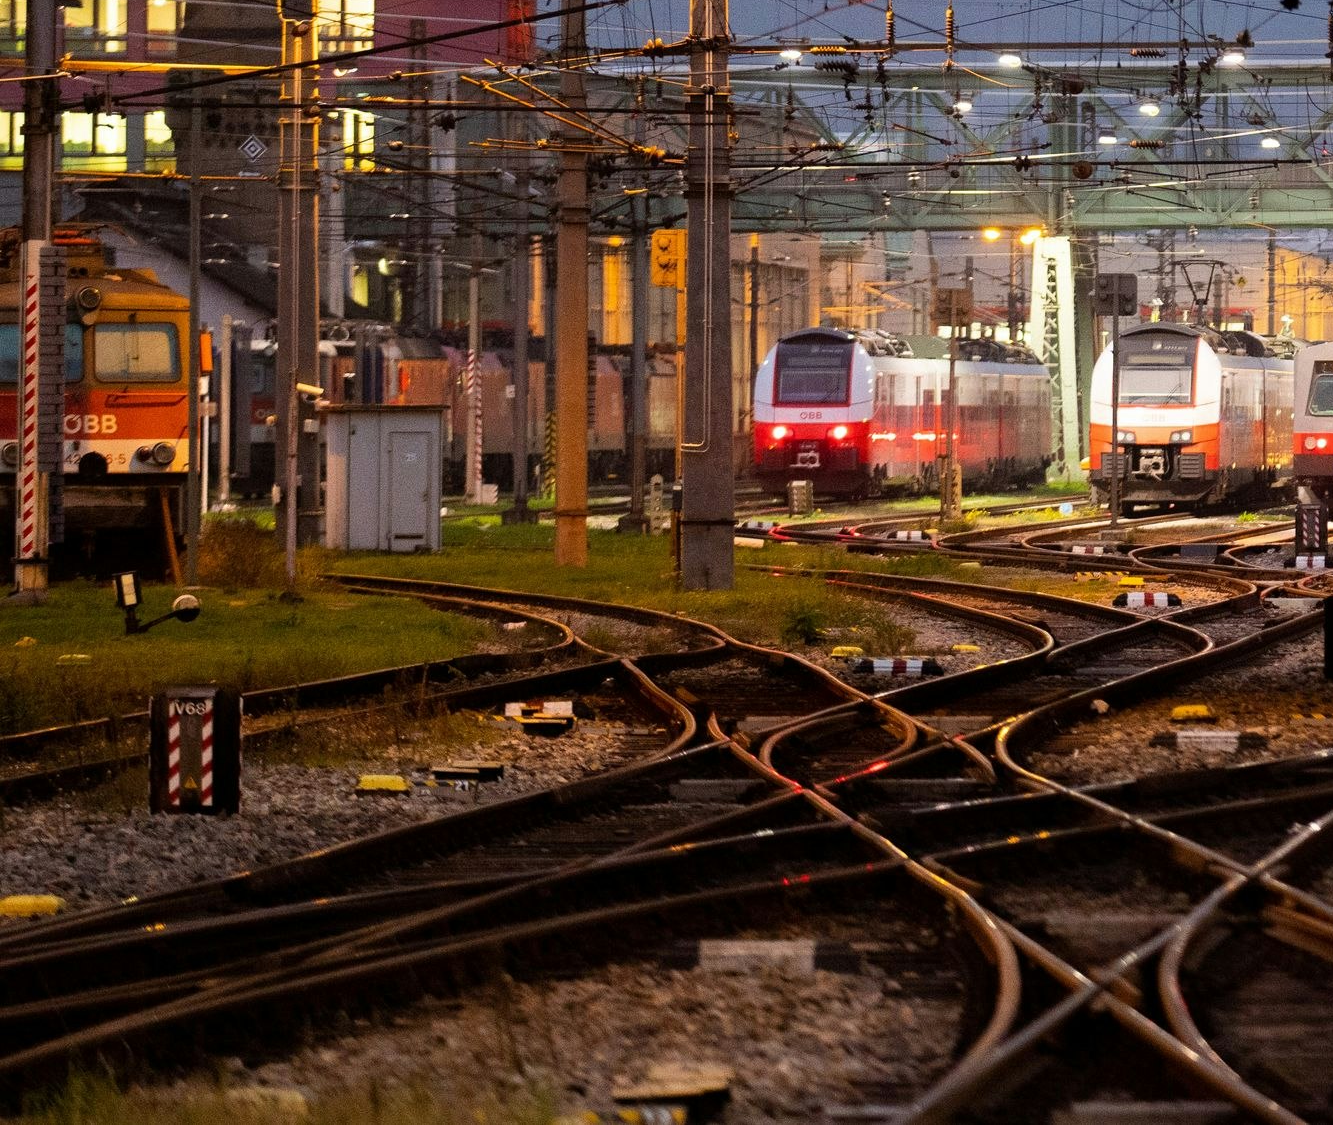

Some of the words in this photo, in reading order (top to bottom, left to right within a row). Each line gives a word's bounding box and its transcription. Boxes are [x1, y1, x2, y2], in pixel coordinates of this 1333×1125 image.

[800, 411, 822, 420] ÖBB
[63, 414, 118, 434] ÖBB
[175, 700, 207, 715] V68
